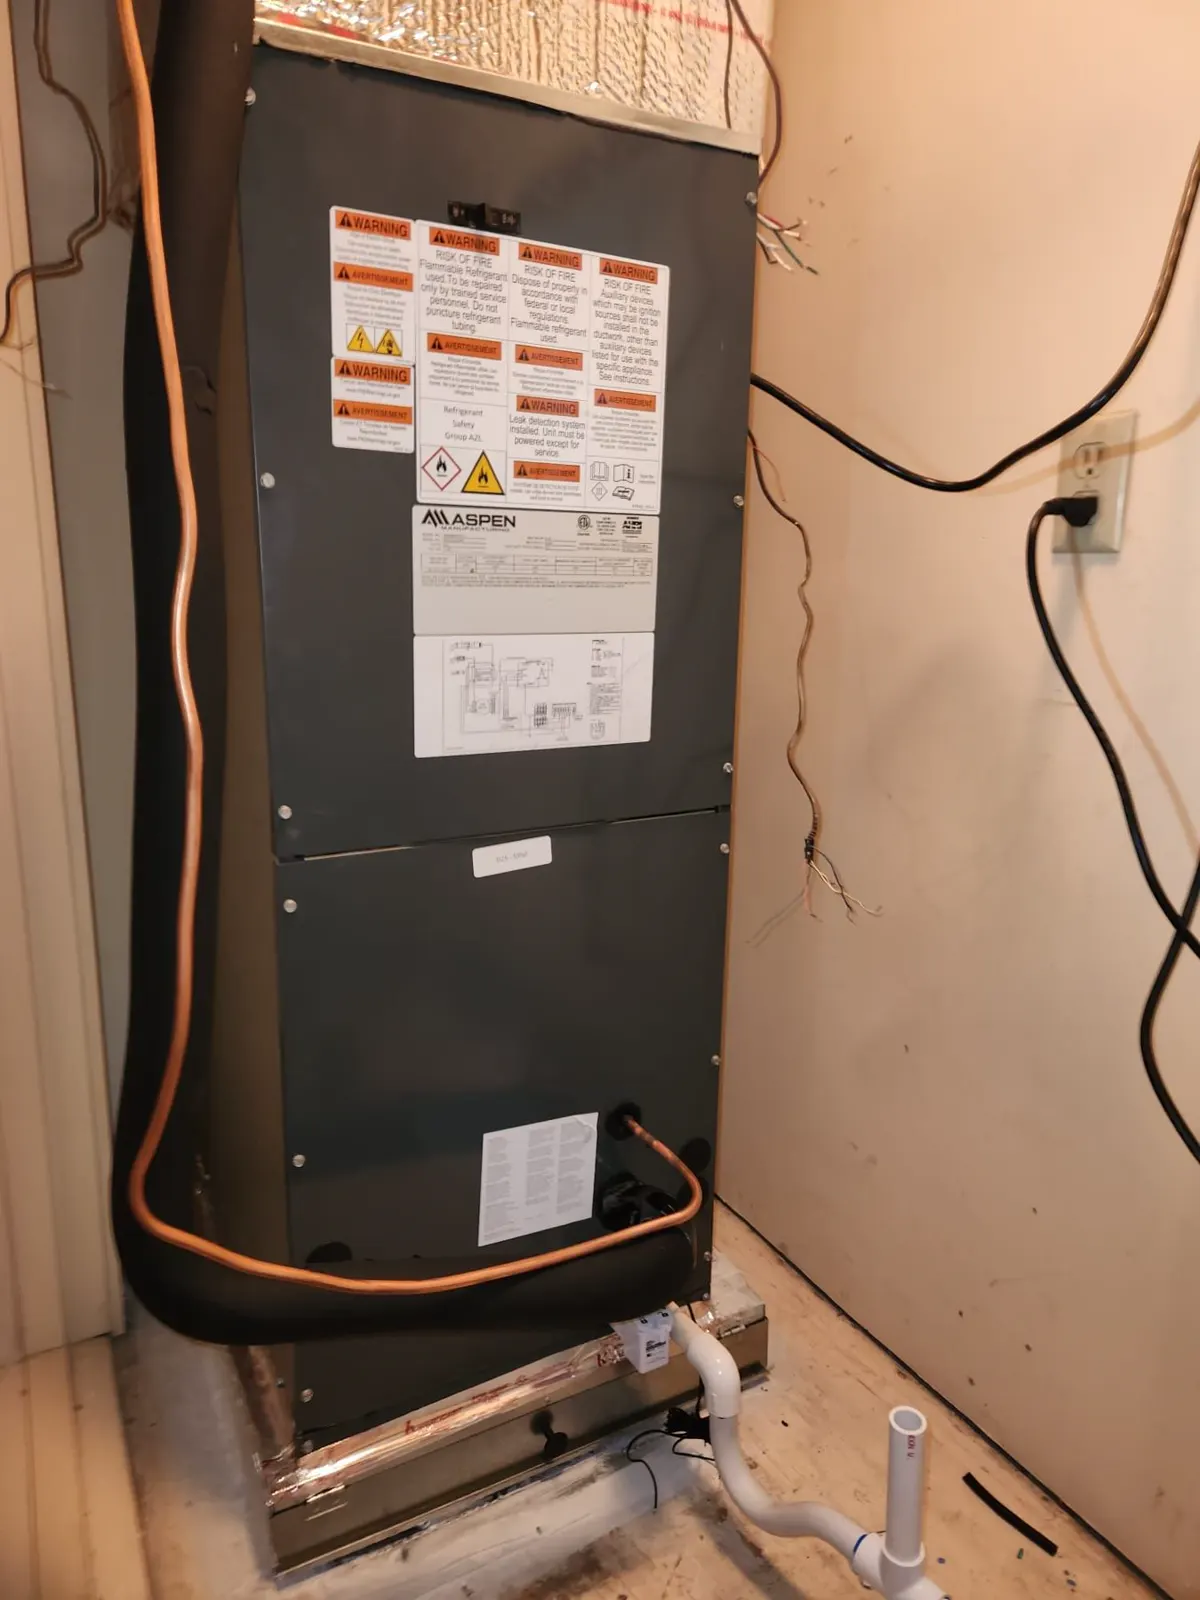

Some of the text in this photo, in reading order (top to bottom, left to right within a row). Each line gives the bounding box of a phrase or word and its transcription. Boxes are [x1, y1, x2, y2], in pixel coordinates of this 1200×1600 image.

[354, 216, 408, 237] WARNING
[446, 233, 496, 252] WARNING
[436, 250, 492, 268] RISK OF FIRE
[534, 250, 580, 268] WARNING
[420, 258, 508, 282] Flammable Refrigerant
[525, 265, 576, 282] RISK OF FIRE
[614, 263, 656, 281] WARNING
[460, 278, 469, 287] be
[472, 280, 502, 292] repaired
[512, 274, 540, 287] Dispose
[543, 280, 550, 288] of
[604, 278, 651, 295] RISK OF FIRE
[421, 283, 507, 303] only by trained service
[522, 288, 578, 304] accordance with
[600, 288, 654, 306] Auxiliary devices
[473, 300, 484, 311] Do
[486, 304, 498, 313] not
[524, 298, 548, 310] federal
[560, 304, 576, 314] local
[593, 300, 612, 308] which
[614, 303, 627, 313] may
[426, 306, 502, 324] puncture refrigerant
[595, 310, 620, 320] sources
[511, 317, 586, 337] Flammable refrigerant
[604, 322, 630, 332] installed
[627, 335, 642, 344] other
[644, 337, 658, 346] than
[600, 342, 652, 356] auxiliary devices
[592, 350, 608, 360] listed
[611, 352, 620, 361] for
[621, 355, 632, 364] use
[635, 356, 648, 365] with
[352, 364, 408, 382] WARNING
[596, 362, 620, 373] specific
[599, 372, 612, 381] See
[444, 406, 484, 417] Refrigerant
[532, 400, 576, 414] WARNING
[452, 420, 475, 430] Safety
[510, 414, 586, 430] Leak detection system
[444, 432, 468, 442] Group
[543, 428, 557, 436] Unit
[558, 429, 574, 438] must
[576, 431, 584, 440] be
[514, 436, 580, 448] powered except for
[452, 513, 516, 528] ASPEN
